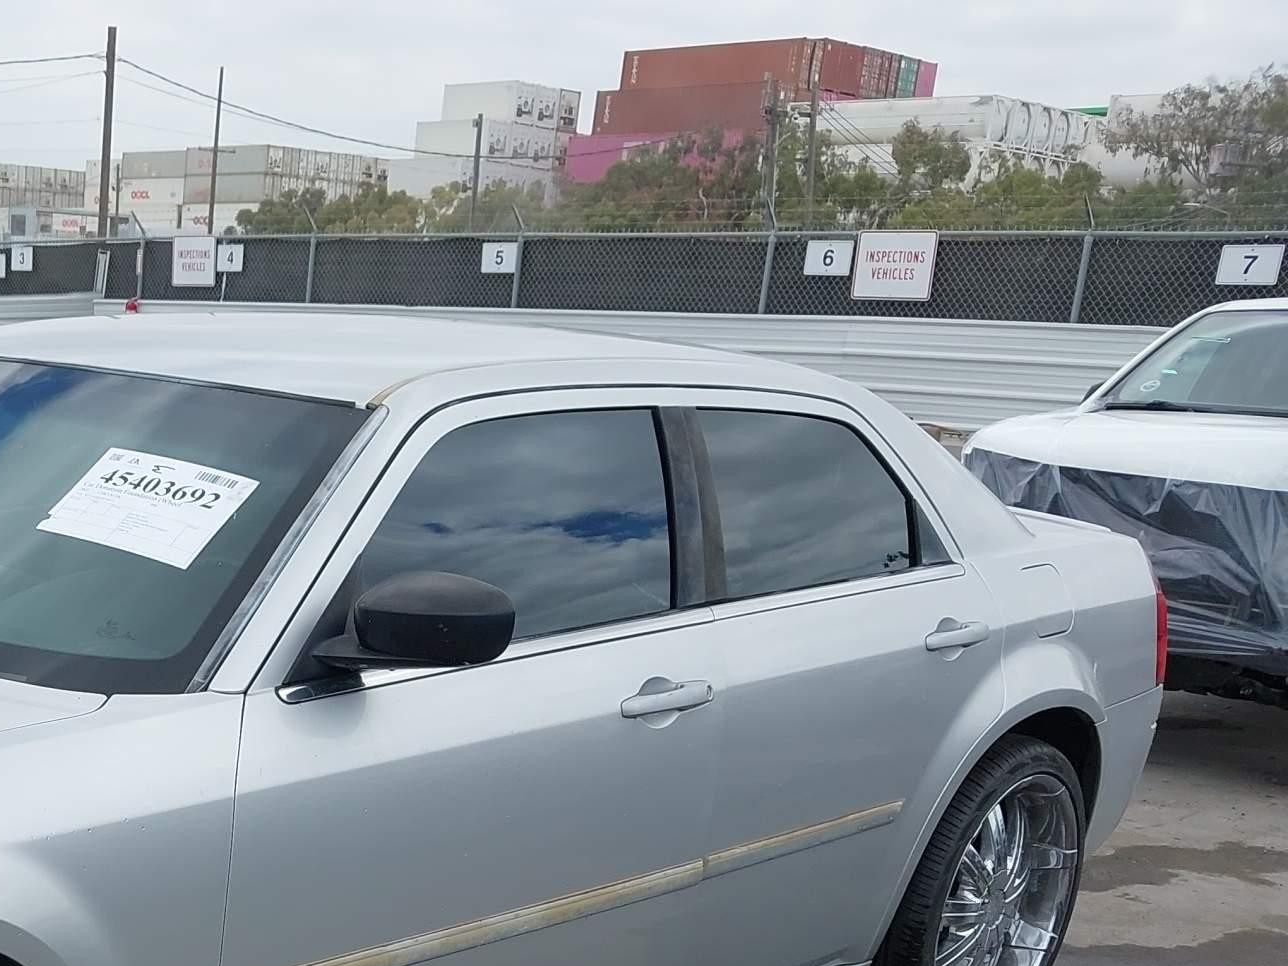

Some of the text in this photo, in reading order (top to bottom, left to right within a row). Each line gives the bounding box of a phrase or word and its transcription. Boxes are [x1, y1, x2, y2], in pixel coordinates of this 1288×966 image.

[18, 252, 25, 265] 3
[227, 251, 234, 264] 4
[495, 250, 504, 265] 5
[822, 249, 835, 267] 6
[865, 250, 927, 264] INSPECTIONS
[181, 262, 206, 272] VEHICLES
[1243, 255, 1259, 275] 7
[871, 267, 916, 281] VEHICLES
[100, 468, 223, 510] 45403692
